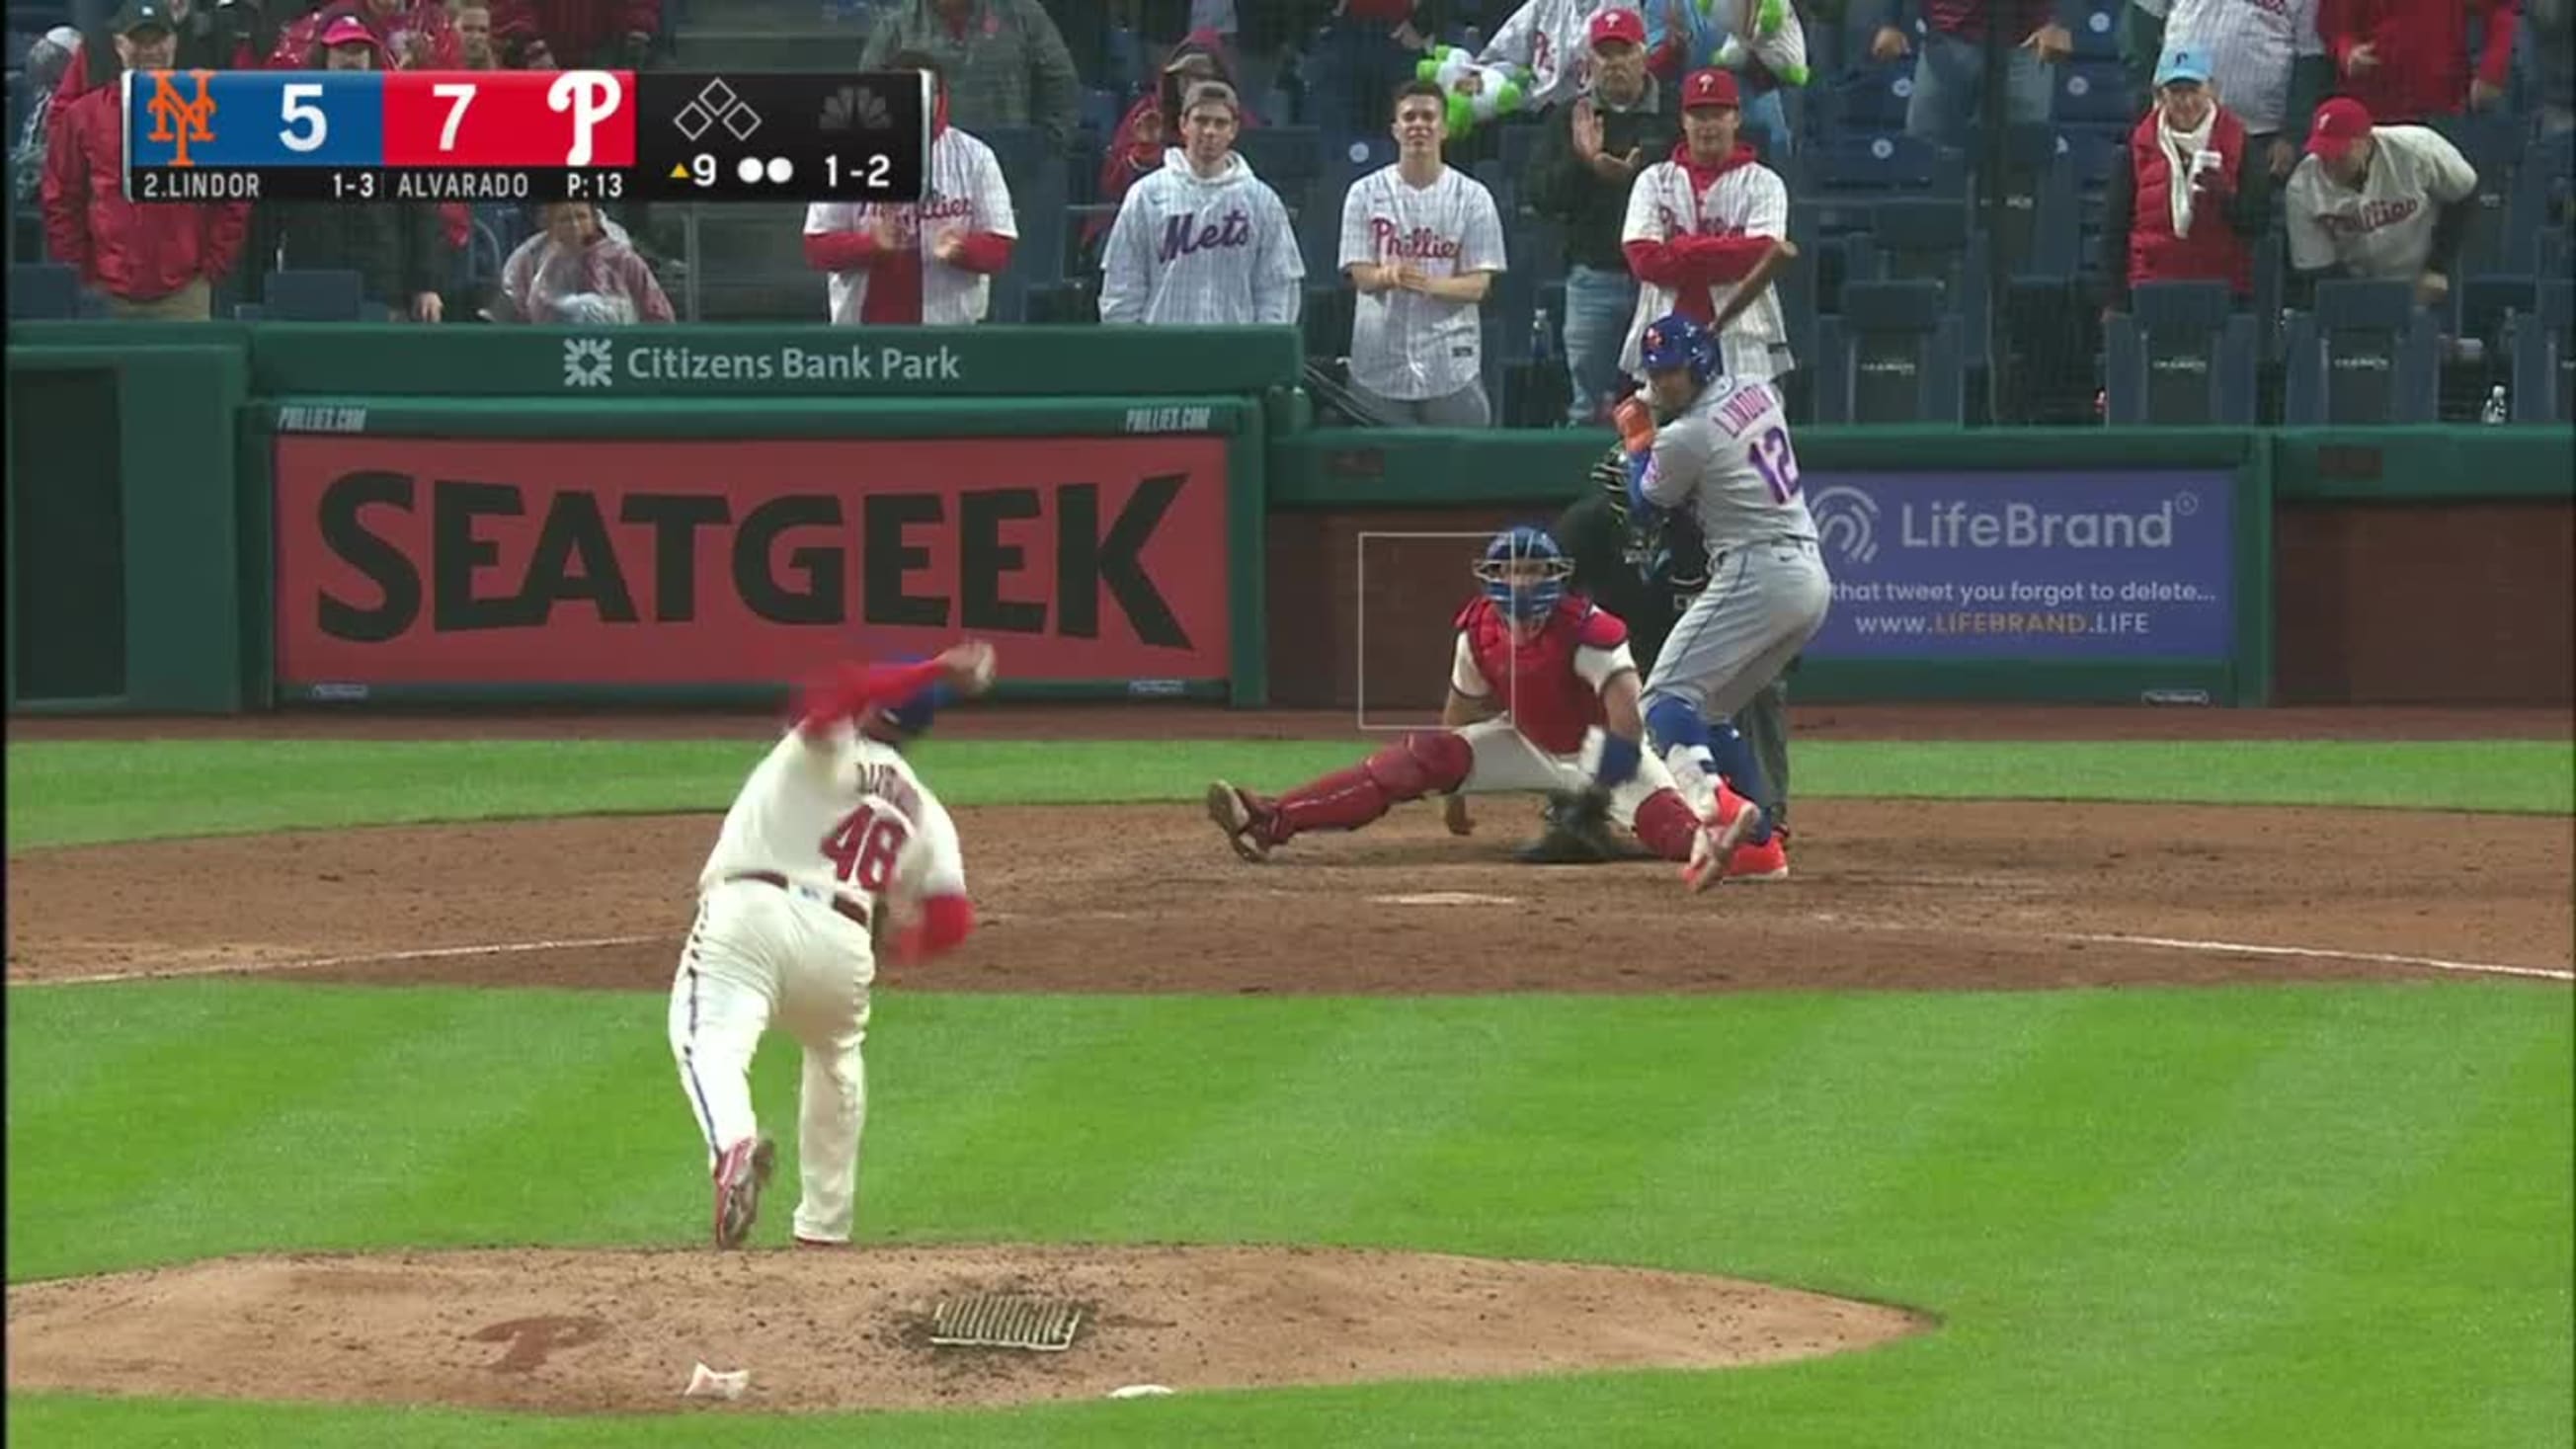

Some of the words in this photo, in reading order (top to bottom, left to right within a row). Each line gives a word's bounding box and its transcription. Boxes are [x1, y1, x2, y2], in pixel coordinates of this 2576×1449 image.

[1159, 209, 1252, 265] Mets
[627, 347, 773, 379] Citizens
[782, 346, 872, 379] Bank
[881, 346, 961, 379] Park
[1747, 427, 1801, 506] 12
[316, 469, 1194, 652] SEATGEEK
[1831, 581, 1882, 602] that
[1885, 582, 1954, 603] tweet
[1961, 586, 2006, 607] you
[2011, 581, 2083, 607] forgot
[2089, 583, 2113, 603] to
[2119, 580, 2216, 603] delete...
[1855, 611, 2151, 635] www.LIFEBRAND.LIFE
[819, 803, 910, 893] 48
